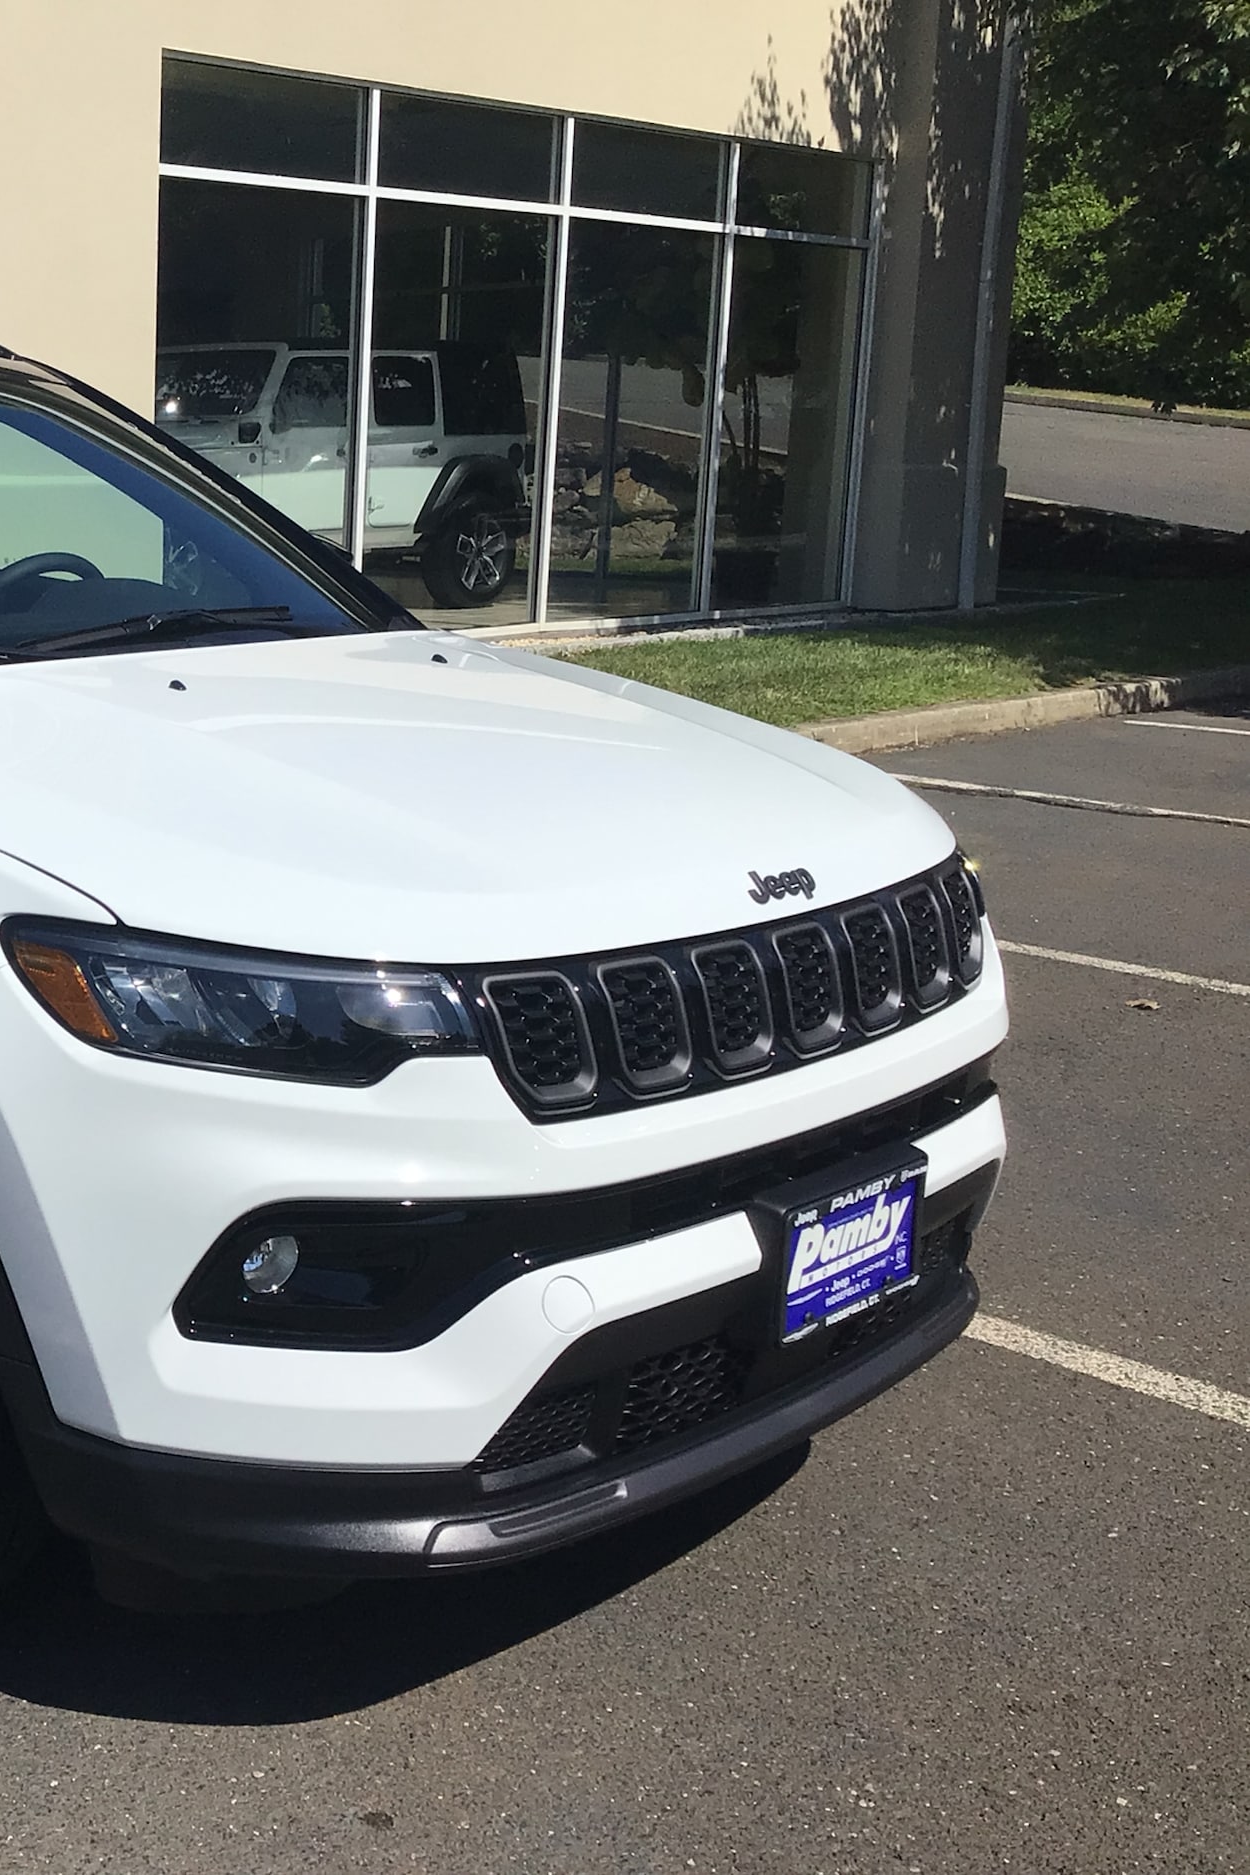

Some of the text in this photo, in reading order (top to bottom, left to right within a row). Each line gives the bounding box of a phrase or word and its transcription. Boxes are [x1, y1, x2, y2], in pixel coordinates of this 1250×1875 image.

[747, 867, 816, 905] Jeep
[830, 1174, 897, 1213] PAMBY
[787, 1193, 912, 1295] Pamby
